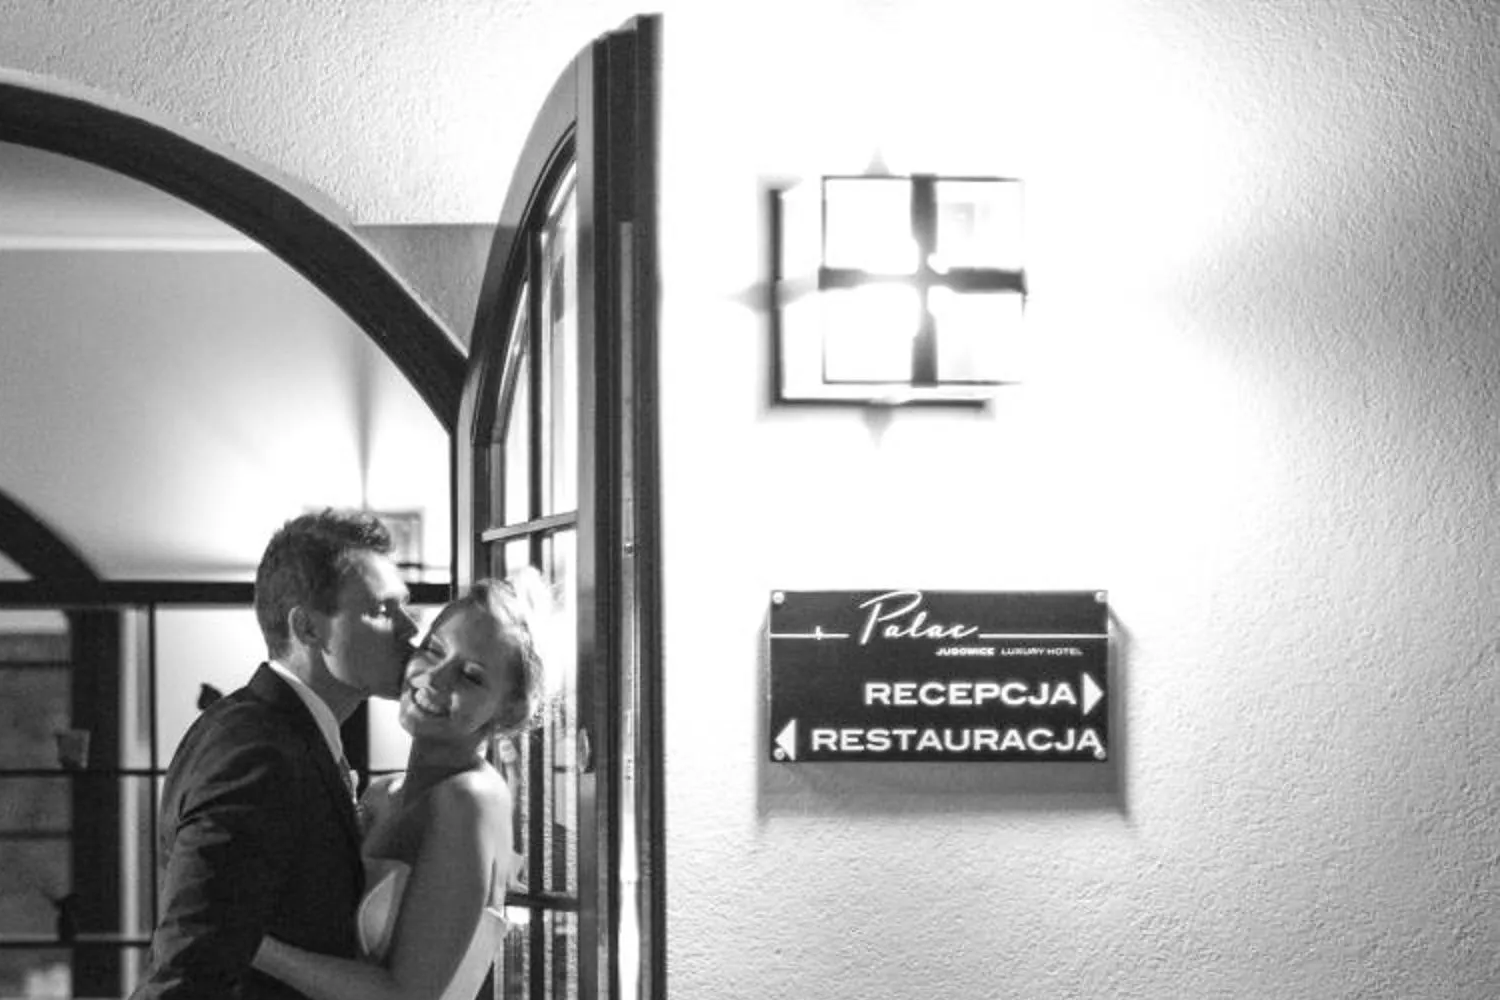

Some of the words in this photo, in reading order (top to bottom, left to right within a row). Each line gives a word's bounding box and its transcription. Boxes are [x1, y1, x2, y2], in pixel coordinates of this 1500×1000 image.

[1047, 647, 1083, 657] HOTEL
[865, 683, 1077, 705] RECEPCJA
[811, 729, 1103, 751] RESTAURACJA
